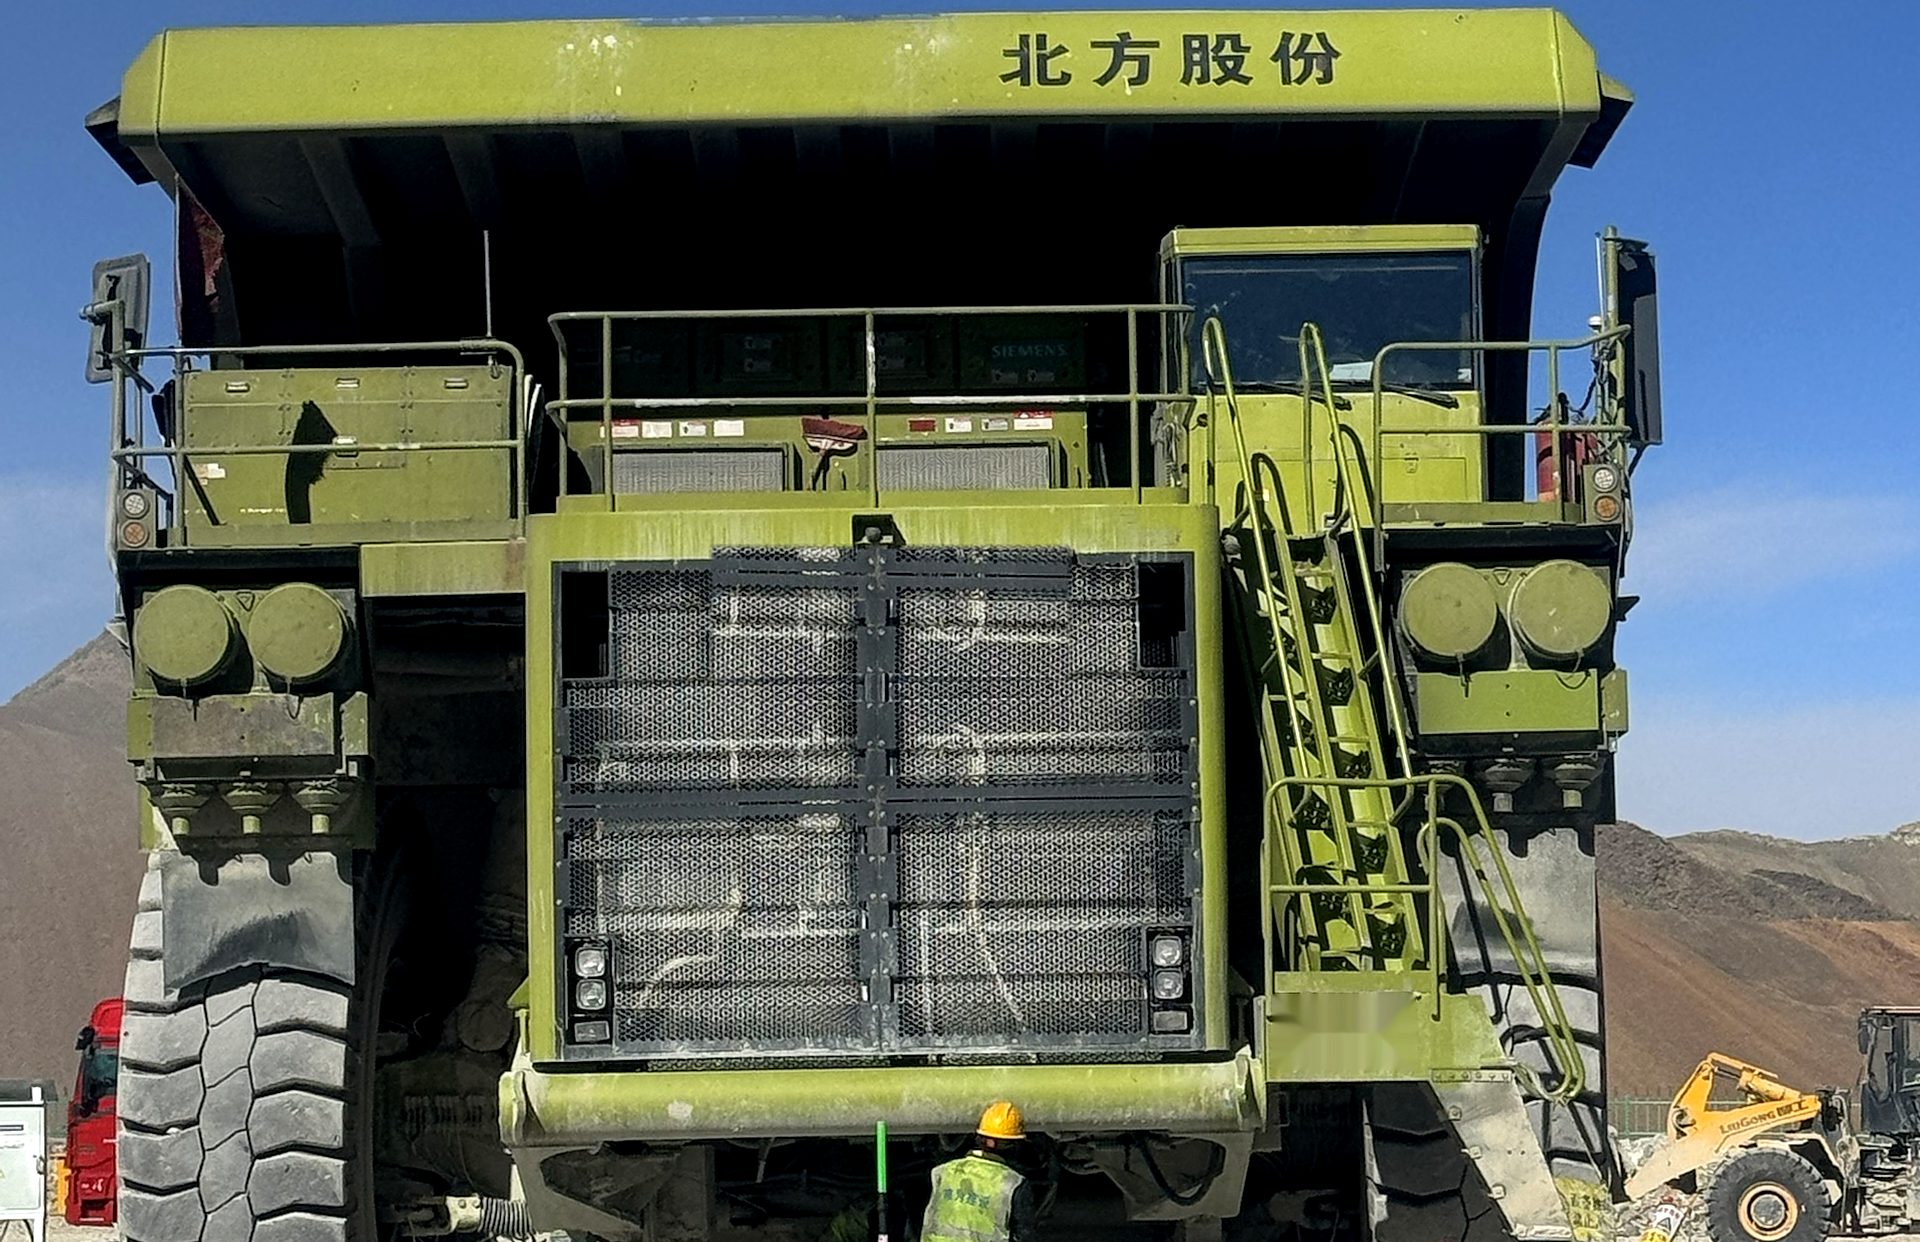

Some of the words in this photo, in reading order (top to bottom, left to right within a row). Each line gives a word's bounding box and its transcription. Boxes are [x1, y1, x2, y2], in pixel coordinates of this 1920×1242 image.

[999, 31, 1342, 87] 北方股份
[991, 343, 1068, 358] SIEMENS
